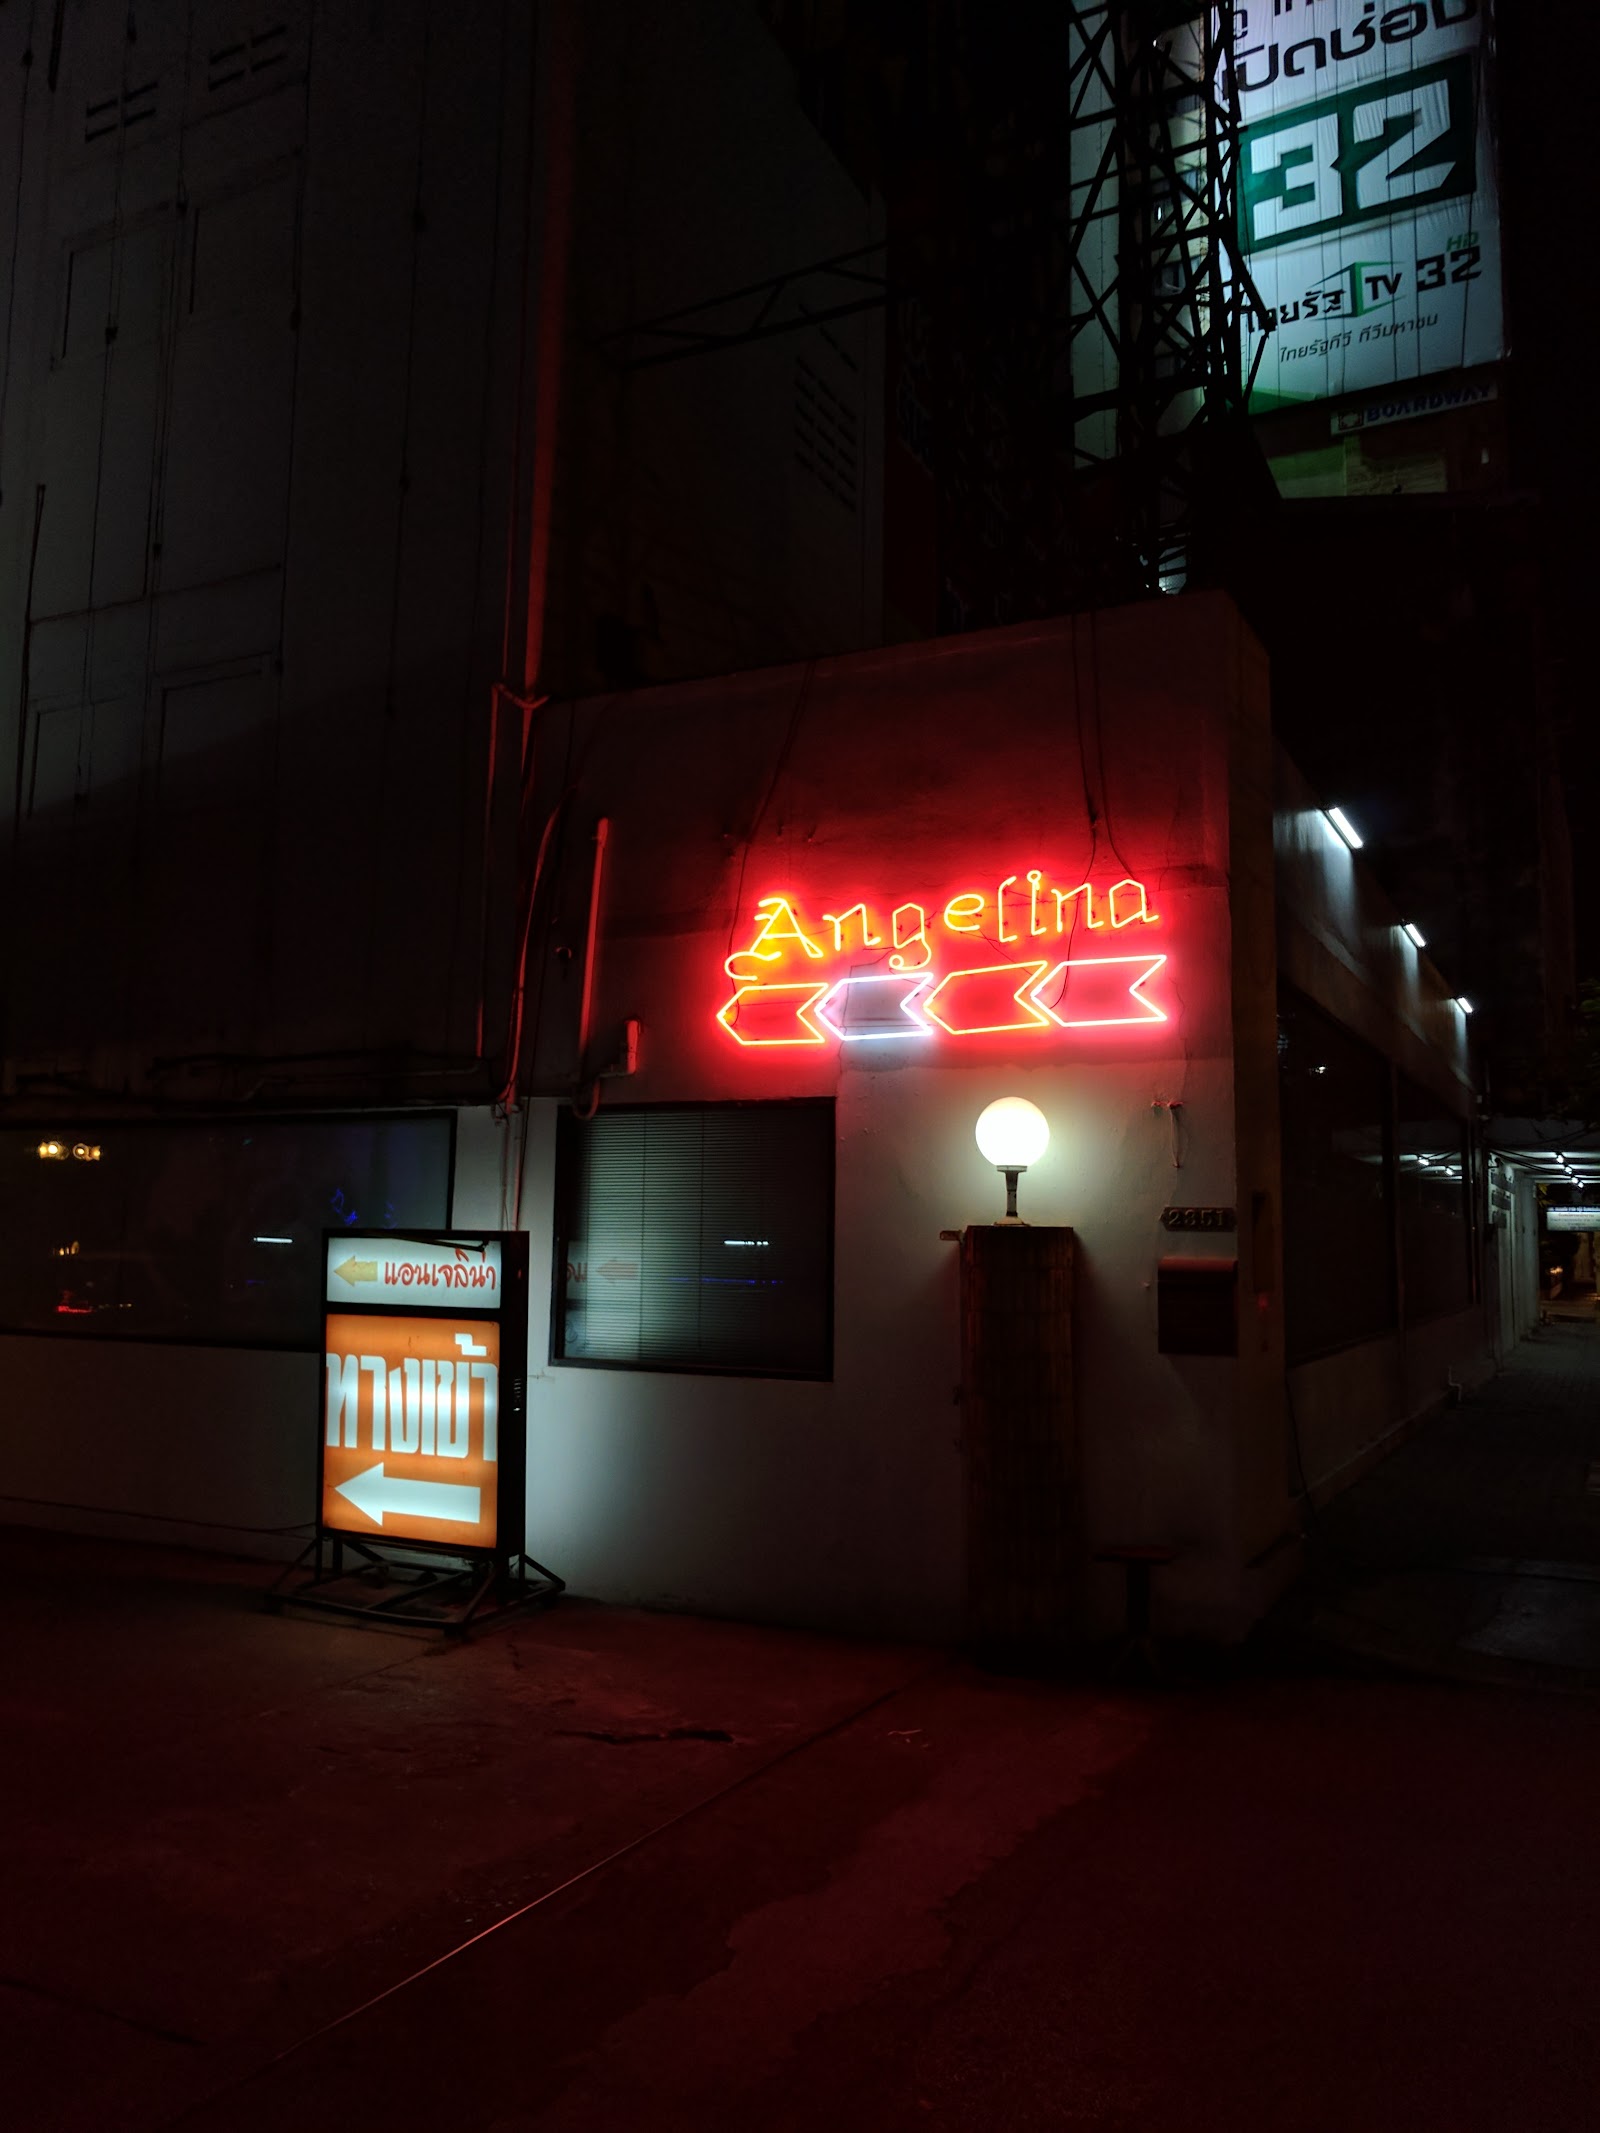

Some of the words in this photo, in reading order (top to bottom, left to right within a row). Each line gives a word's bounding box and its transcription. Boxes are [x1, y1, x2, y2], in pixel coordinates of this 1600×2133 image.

[1250, 79, 1456, 242] 32
[1365, 272, 1403, 301] TV
[1416, 245, 1483, 292] 32
[724, 869, 1159, 982] Angelina
[325, 1332, 499, 1463] ทางเข้า
